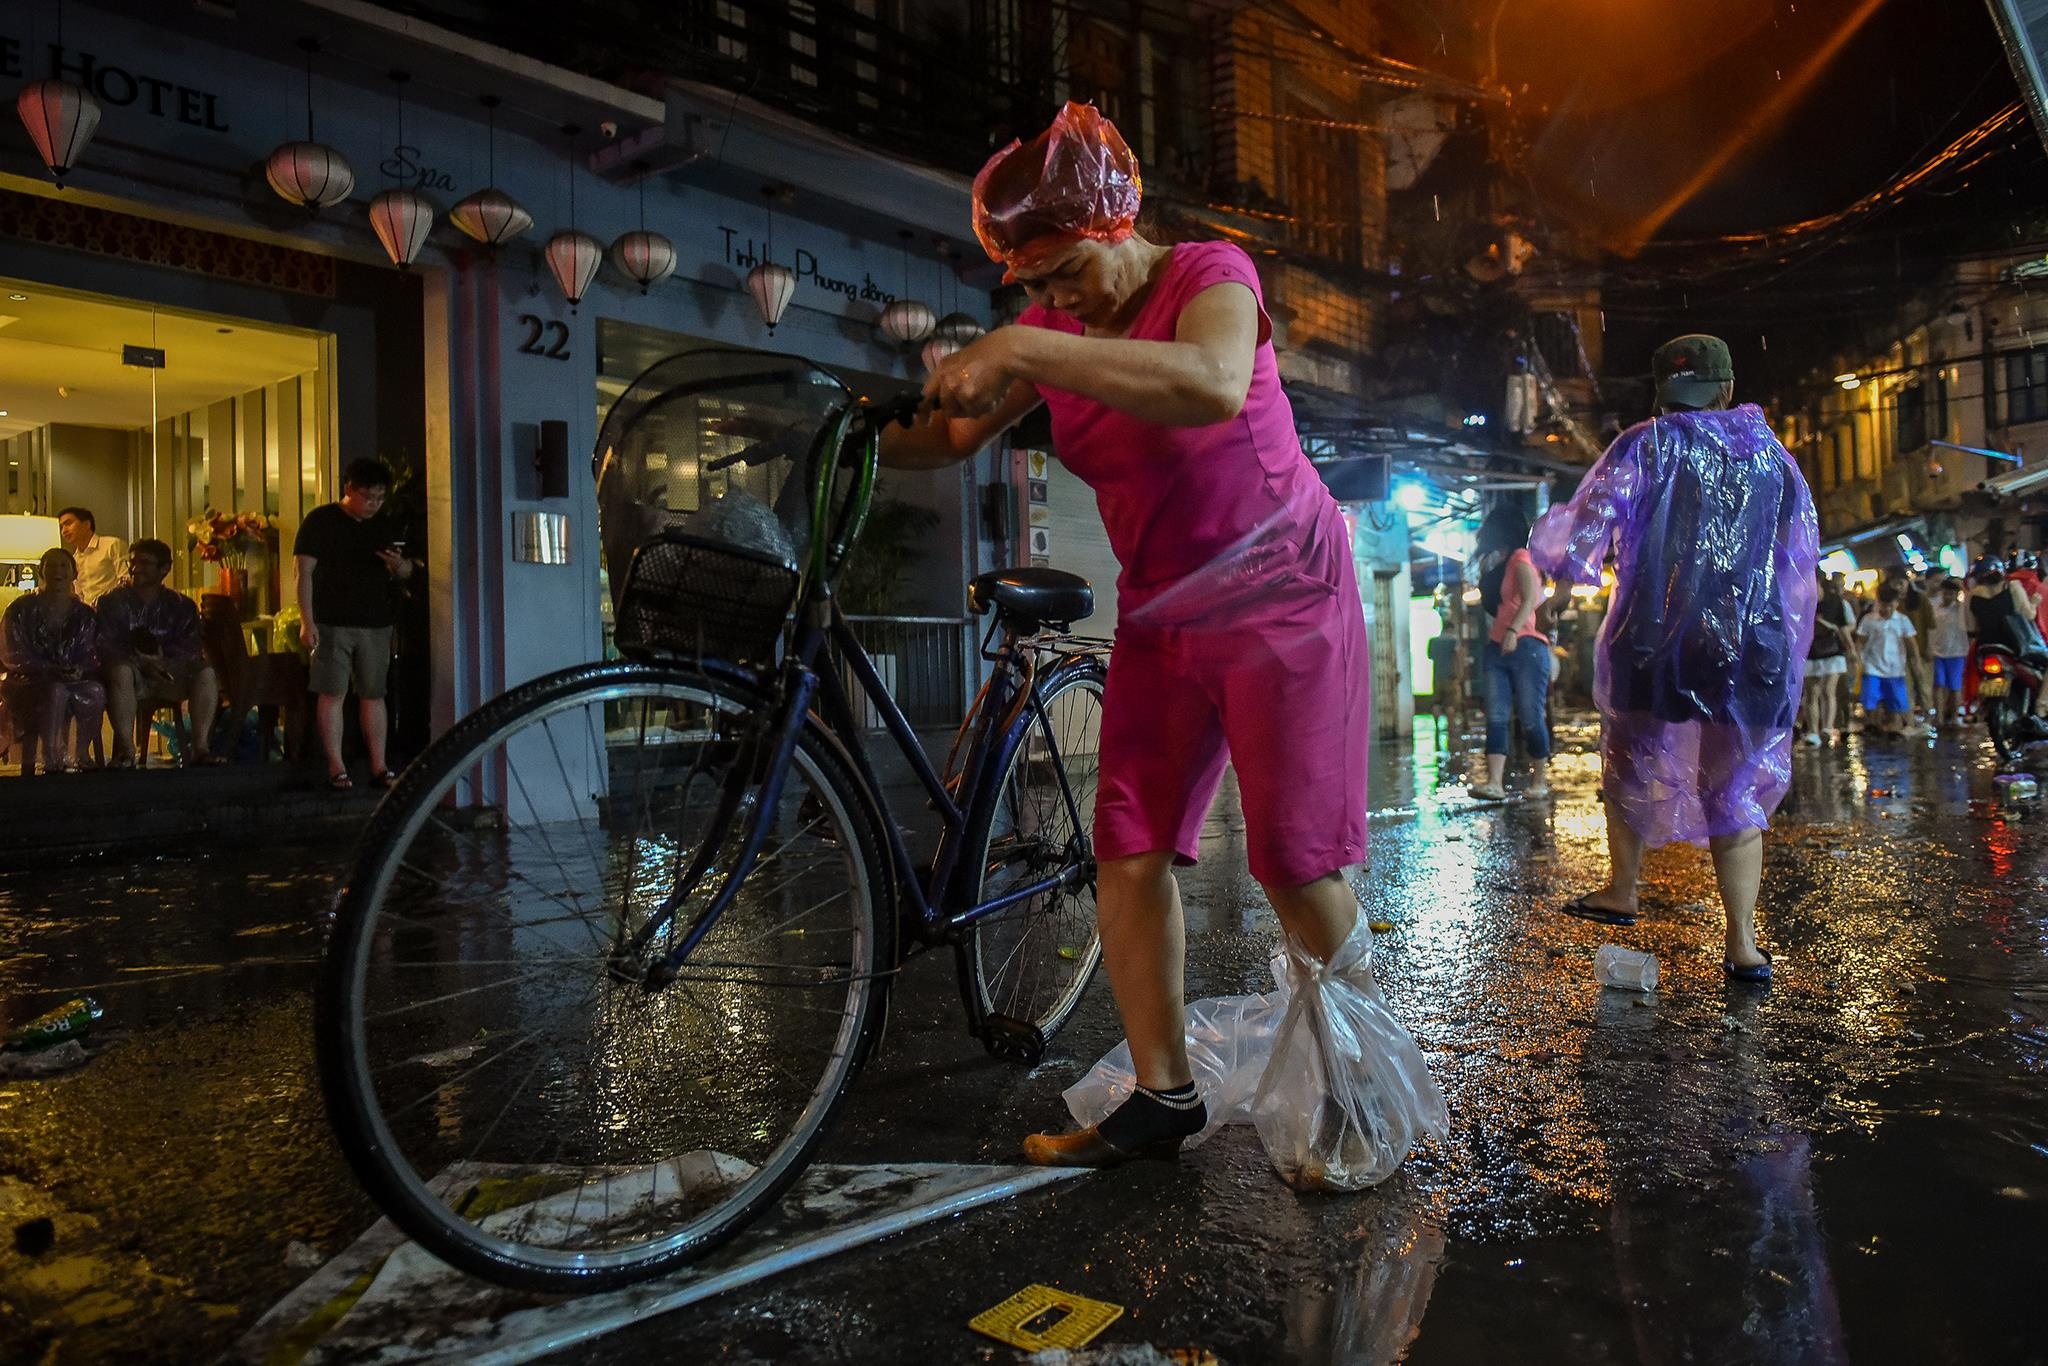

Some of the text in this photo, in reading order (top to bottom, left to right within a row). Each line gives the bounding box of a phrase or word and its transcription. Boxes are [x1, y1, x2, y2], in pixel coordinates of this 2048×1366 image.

[48, 44, 229, 132] HOTEL
[379, 145, 457, 192] Spa
[517, 314, 571, 361] 22
